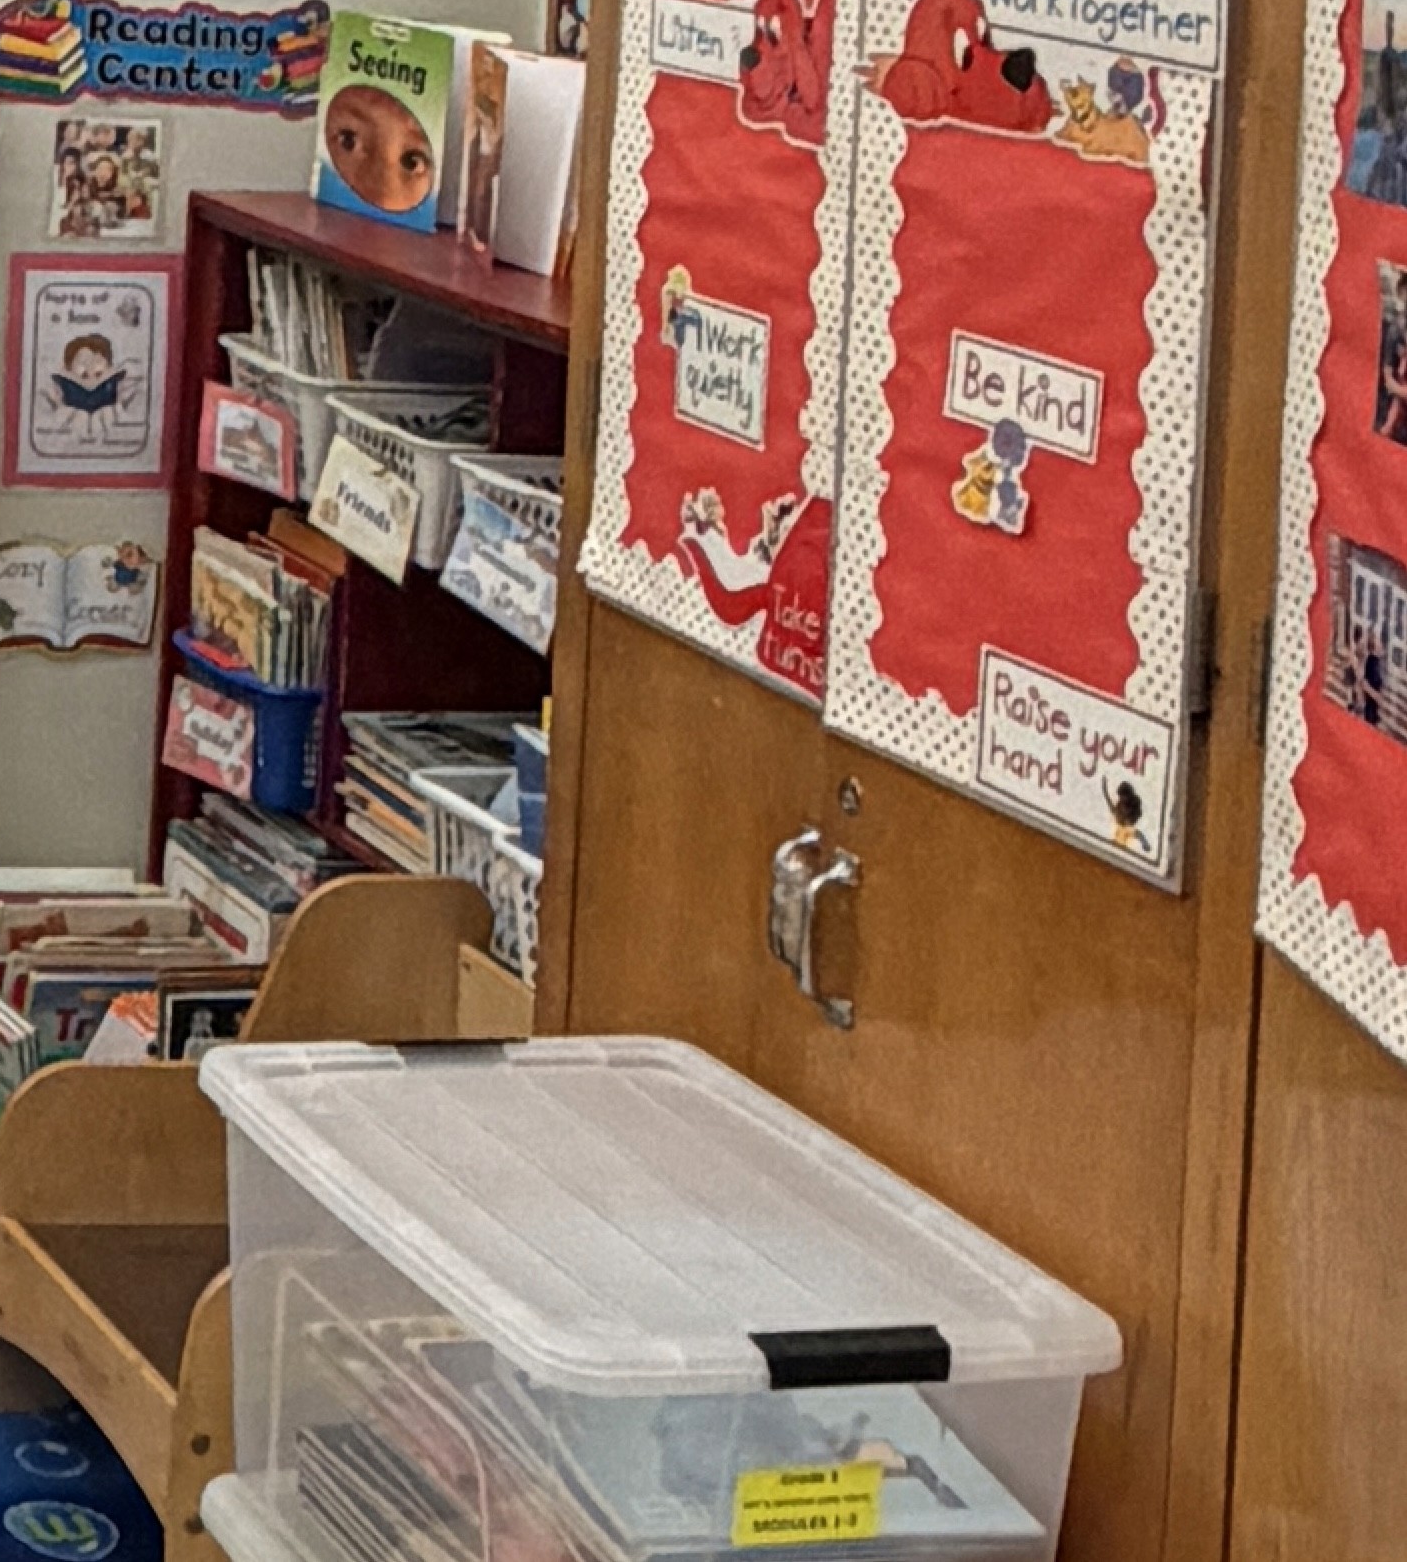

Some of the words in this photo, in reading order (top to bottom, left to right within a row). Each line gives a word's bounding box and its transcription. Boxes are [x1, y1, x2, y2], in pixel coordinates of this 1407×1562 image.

[89, 7, 268, 56] Reading
[657, 10, 725, 62] Listen
[97, 52, 249, 92] Center
[348, 39, 428, 96] Seeing
[703, 317, 763, 366] Work
[686, 361, 755, 431] quietly
[961, 349, 1006, 408] Be
[1016, 364, 1086, 436] kind
[337, 479, 393, 535] Friends
[771, 582, 822, 639] Take
[993, 670, 1071, 742] Raise
[1078, 726, 1160, 778] your
[989, 724, 1063, 795] hand
